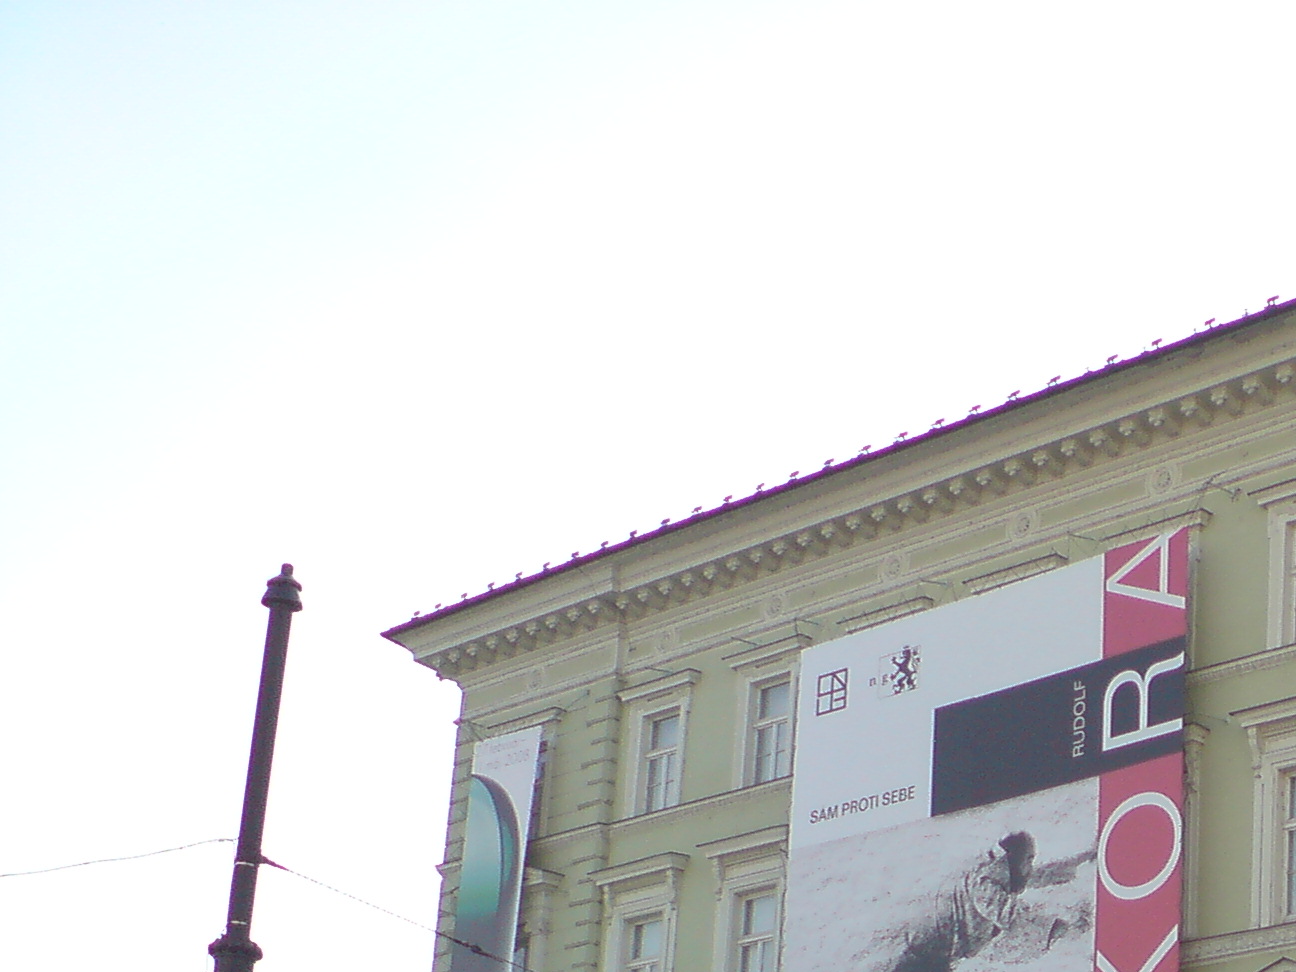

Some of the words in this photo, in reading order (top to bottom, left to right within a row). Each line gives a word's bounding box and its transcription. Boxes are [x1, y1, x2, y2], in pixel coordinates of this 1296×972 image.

[1072, 679, 1085, 757] RUDOLF
[810, 806, 838, 824] SAM
[842, 794, 879, 816] PROTI
[882, 785, 915, 806] SEBE
